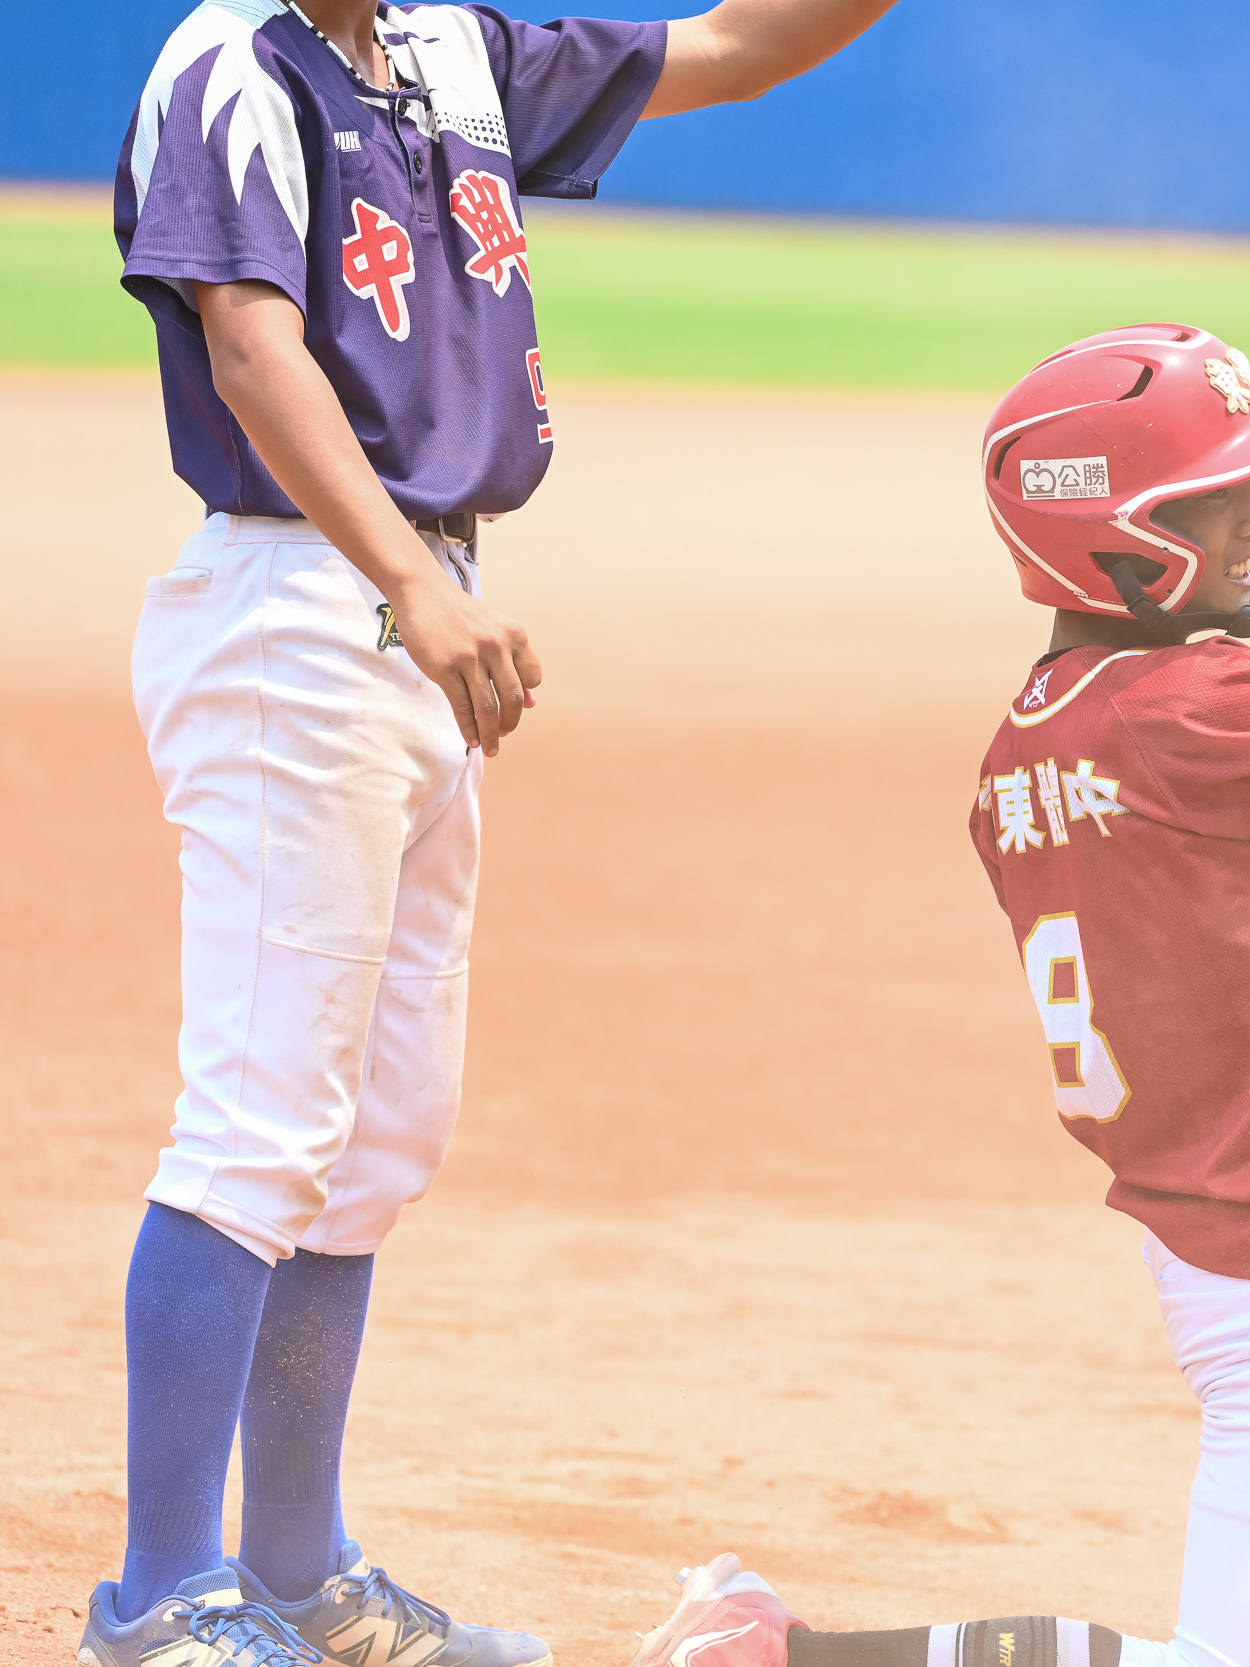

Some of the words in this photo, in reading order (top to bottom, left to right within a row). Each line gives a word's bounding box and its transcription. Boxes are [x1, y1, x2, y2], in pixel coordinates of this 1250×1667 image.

[1058, 463, 1107, 487] 公勝
[1060, 487, 1108, 497] 保險經紀人
[1022, 910, 1132, 1124] 8
